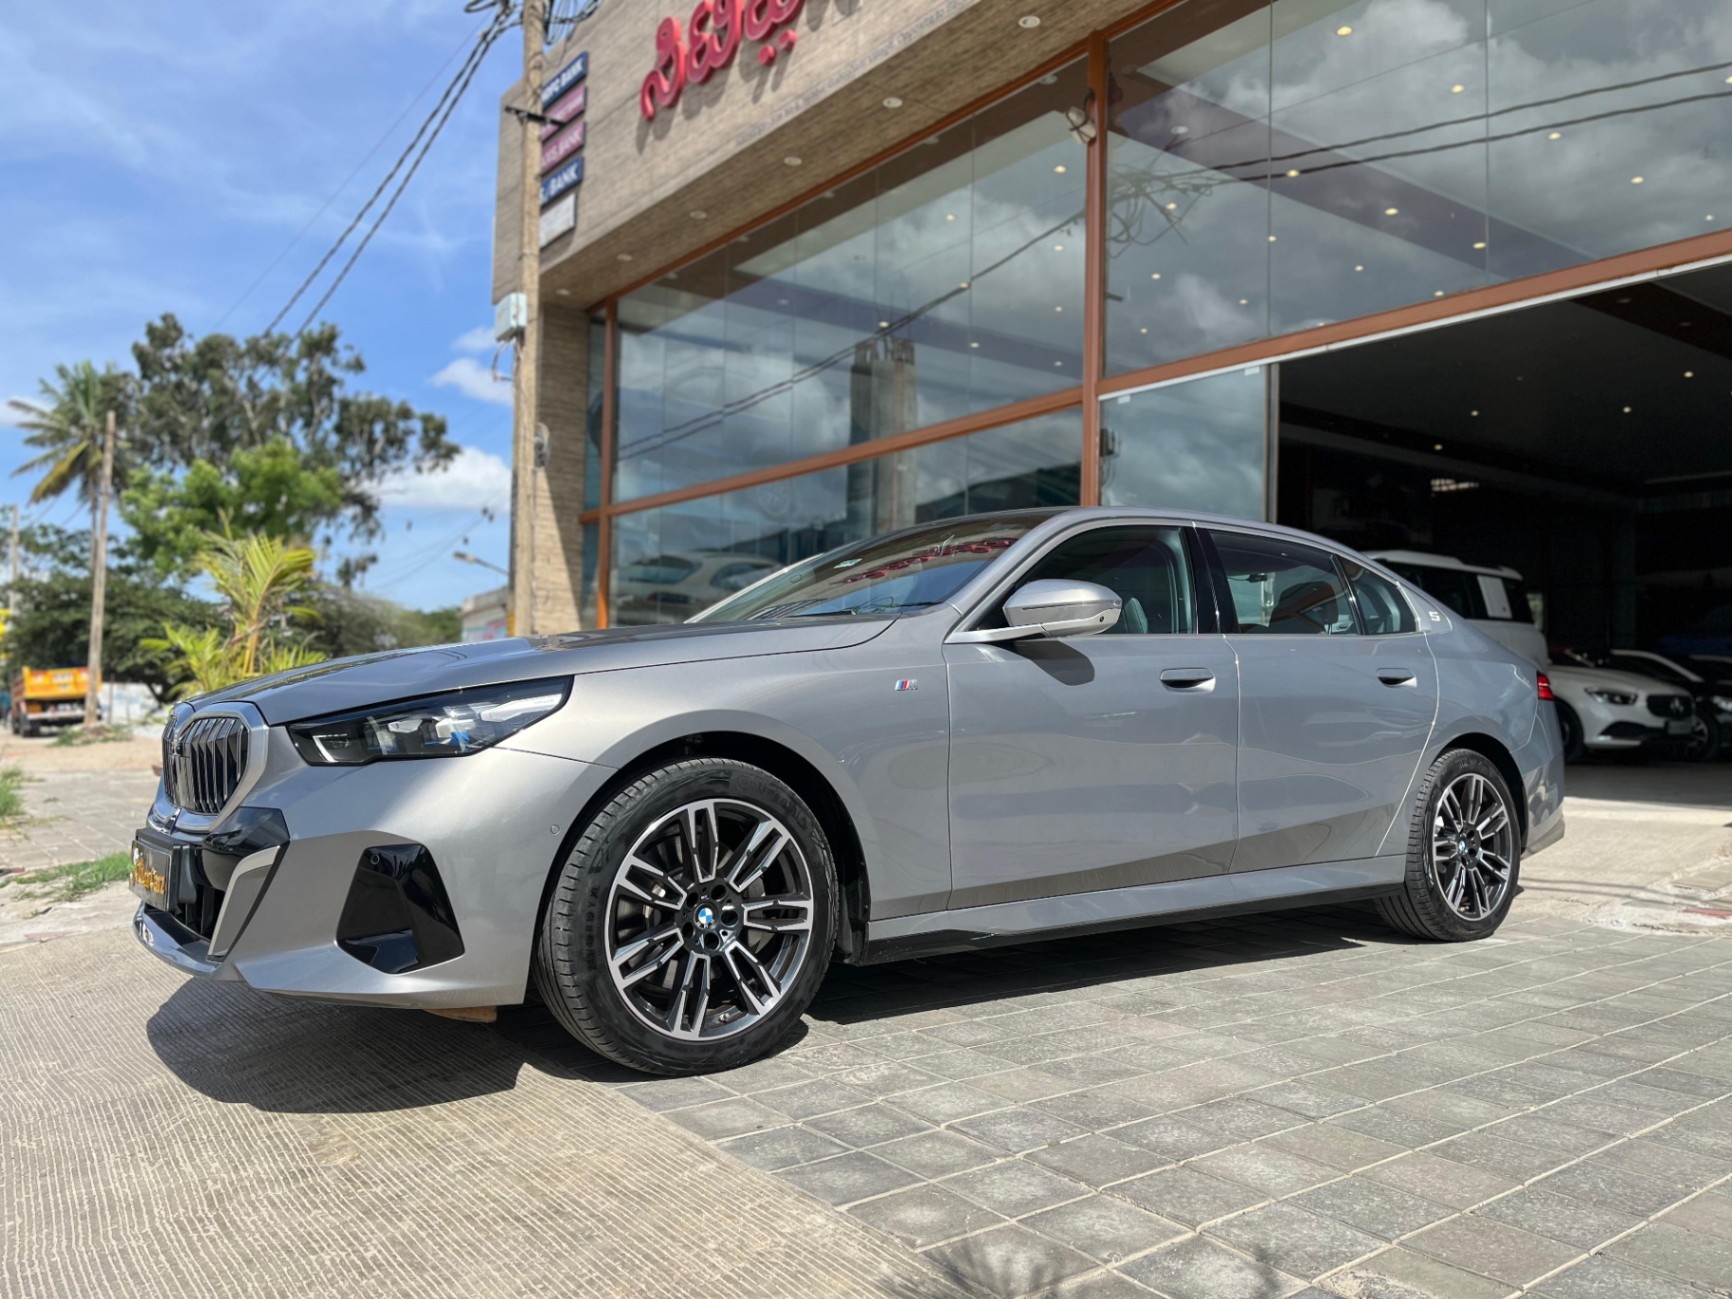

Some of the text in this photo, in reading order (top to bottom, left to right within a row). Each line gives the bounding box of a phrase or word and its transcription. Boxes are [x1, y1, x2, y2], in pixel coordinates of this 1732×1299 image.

[561, 57, 583, 81] BANK
[559, 130, 581, 154] BANK
[550, 163, 578, 196] BANK
